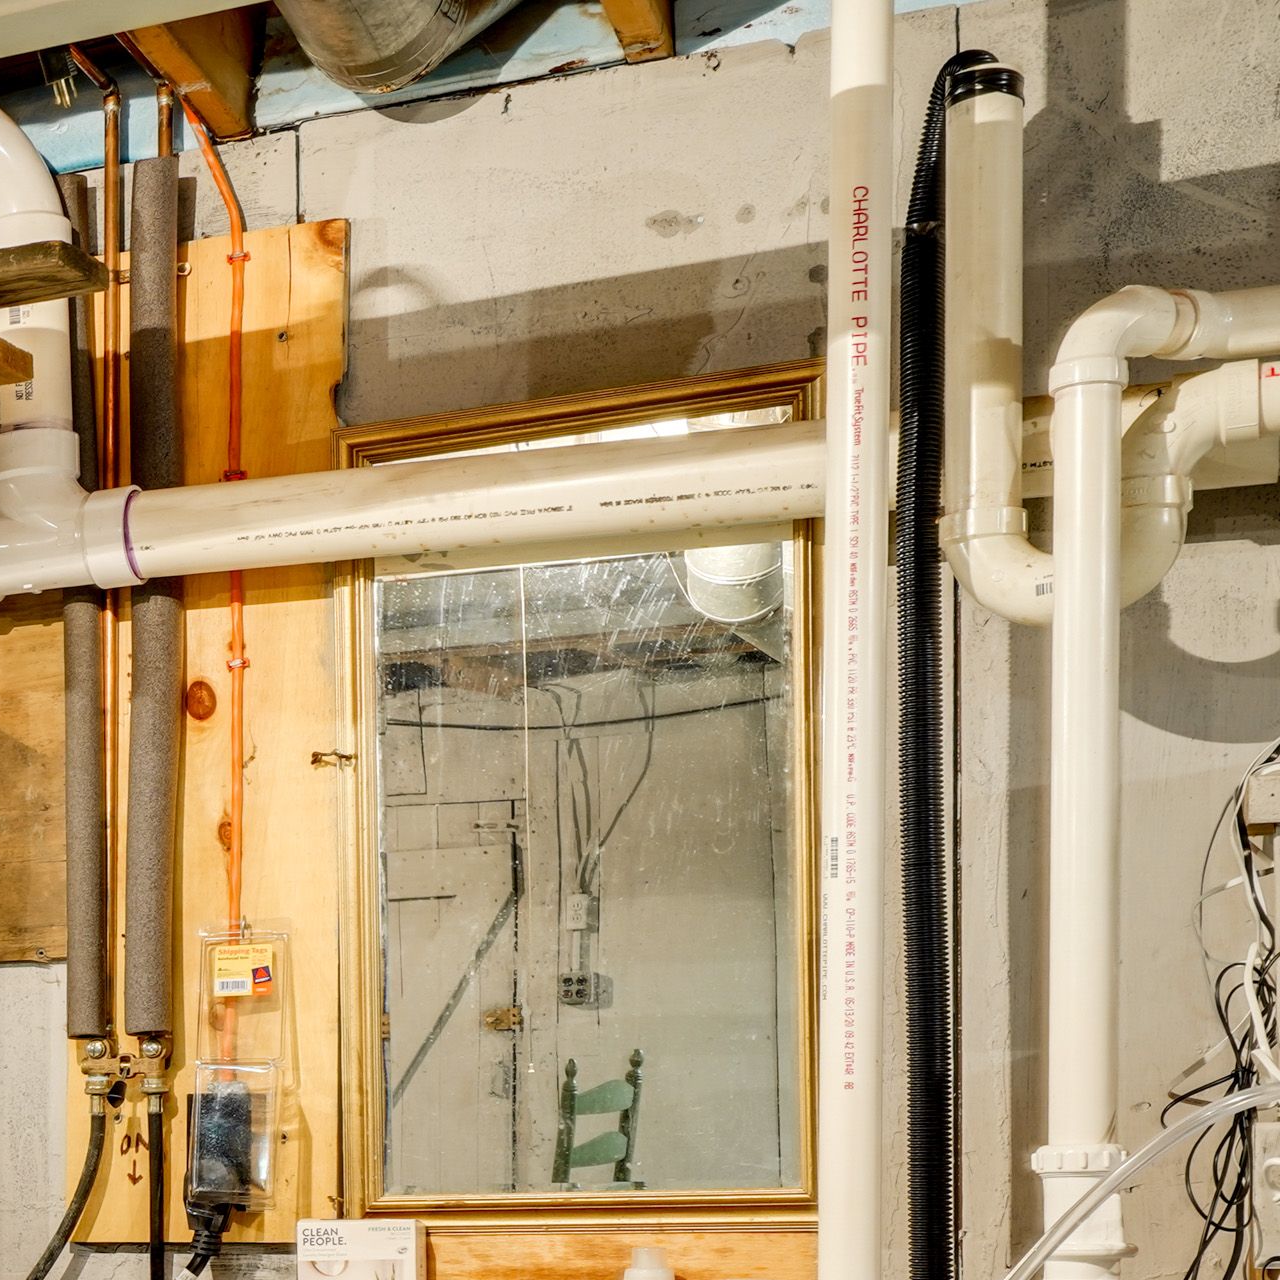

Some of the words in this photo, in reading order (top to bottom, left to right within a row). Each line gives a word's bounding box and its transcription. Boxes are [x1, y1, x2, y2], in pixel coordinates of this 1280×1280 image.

[851, 186, 869, 304] CHARLOTTE
[850, 511, 860, 526] TYPE
[848, 590, 858, 606] ASTM
[848, 654, 858, 666] PVC
[847, 832, 856, 846] ASTM
[844, 941, 856, 956] MADE
[844, 960, 856, 968] IN
[120, 1132, 149, 1156] ON
[302, 1228, 338, 1237] CLEAN
[302, 1236, 347, 1246] PEOPLE.
